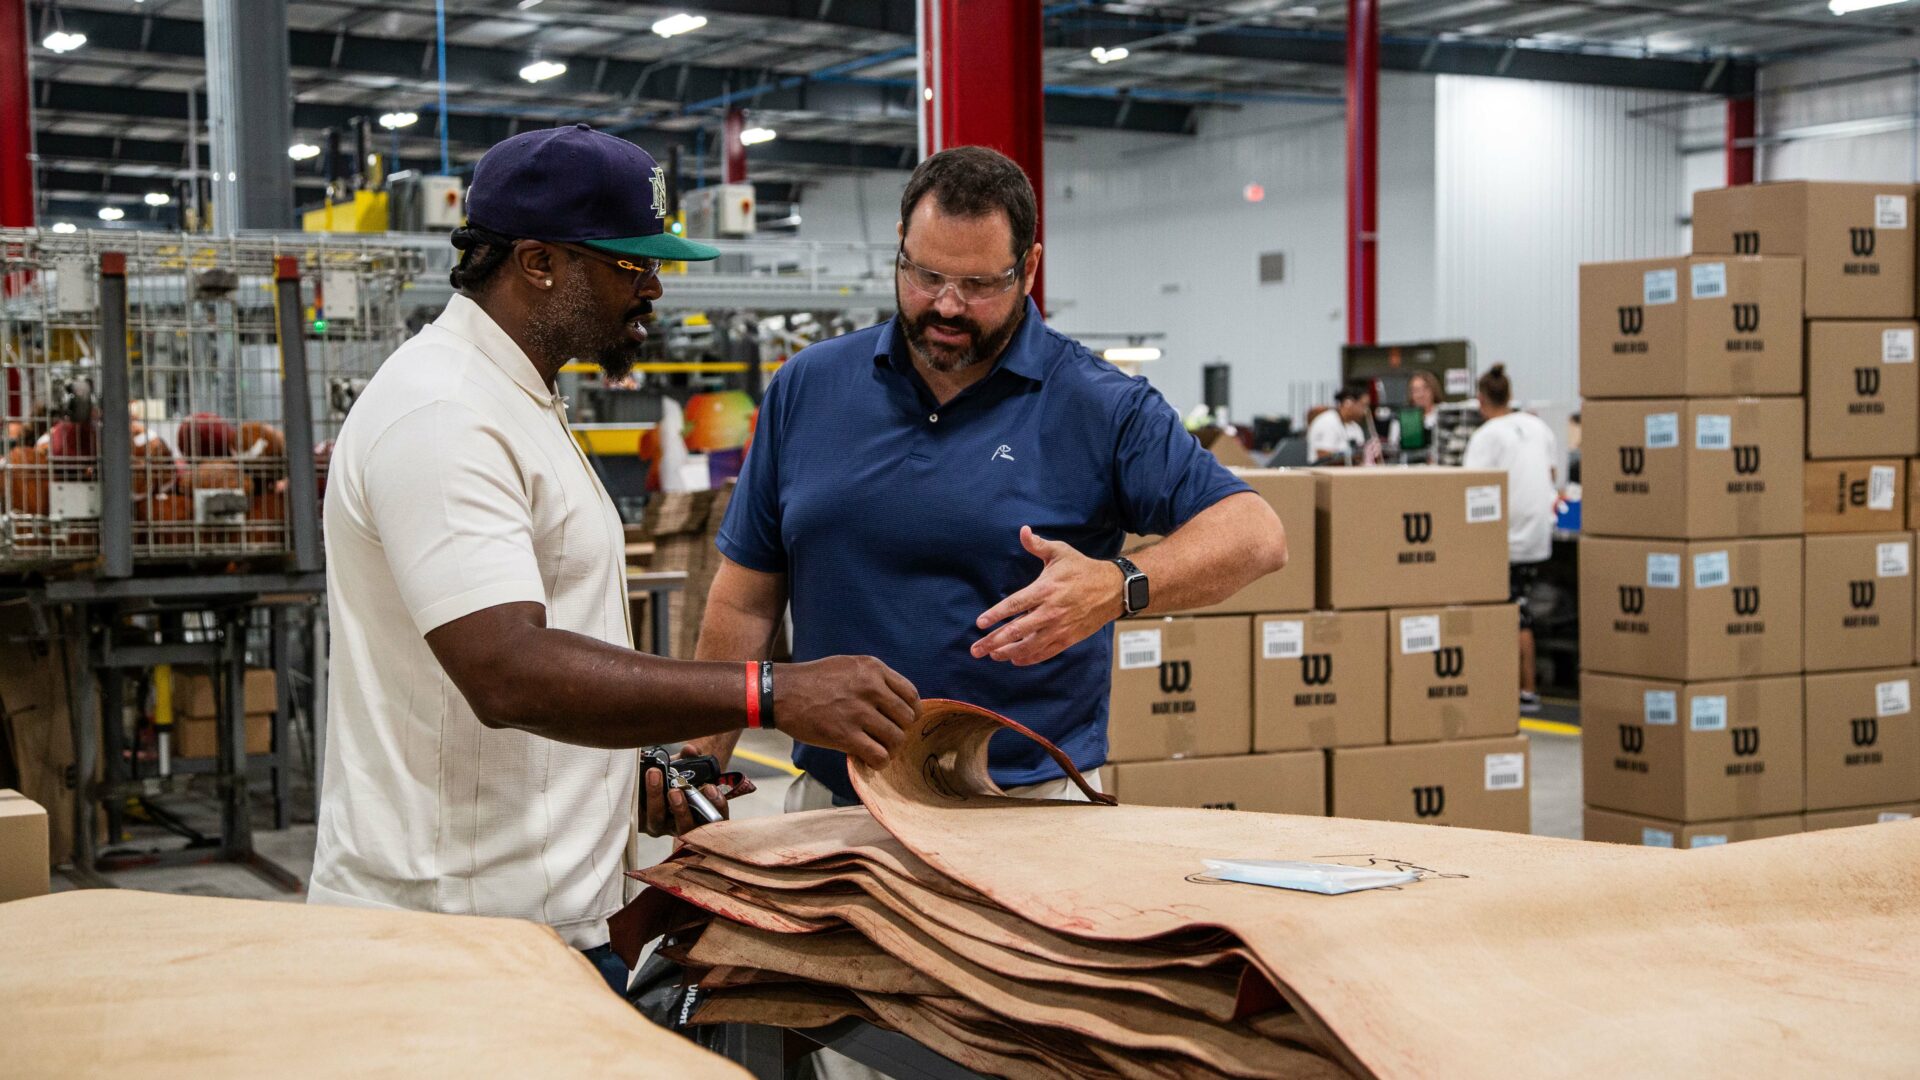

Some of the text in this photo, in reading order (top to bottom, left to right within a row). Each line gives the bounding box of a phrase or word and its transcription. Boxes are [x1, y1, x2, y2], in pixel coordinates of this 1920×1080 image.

[1850, 228, 1875, 257] W
[1618, 306, 1643, 335] W
[1733, 303, 1759, 333] W
[1854, 368, 1880, 396] W
[1619, 447, 1644, 476] W
[1733, 445, 1760, 475] W
[1403, 513, 1432, 544] W
[1398, 553, 1414, 564] MADE
[1424, 552, 1435, 563] USA
[1619, 586, 1644, 615] W
[1733, 586, 1760, 616] W
[1850, 581, 1875, 609] W
[1300, 654, 1332, 686] W
[1433, 647, 1464, 678] W
[1158, 661, 1191, 694] W
[1428, 686, 1446, 698] MADE
[1456, 685, 1468, 697] USA
[1152, 702, 1172, 714] MADE
[1182, 701, 1196, 713] USA
[1294, 694, 1312, 706] MADE
[1323, 693, 1336, 705] USA
[1619, 724, 1644, 754] W
[1732, 727, 1759, 757] W
[1851, 718, 1877, 747] W
[1413, 786, 1444, 818] W
